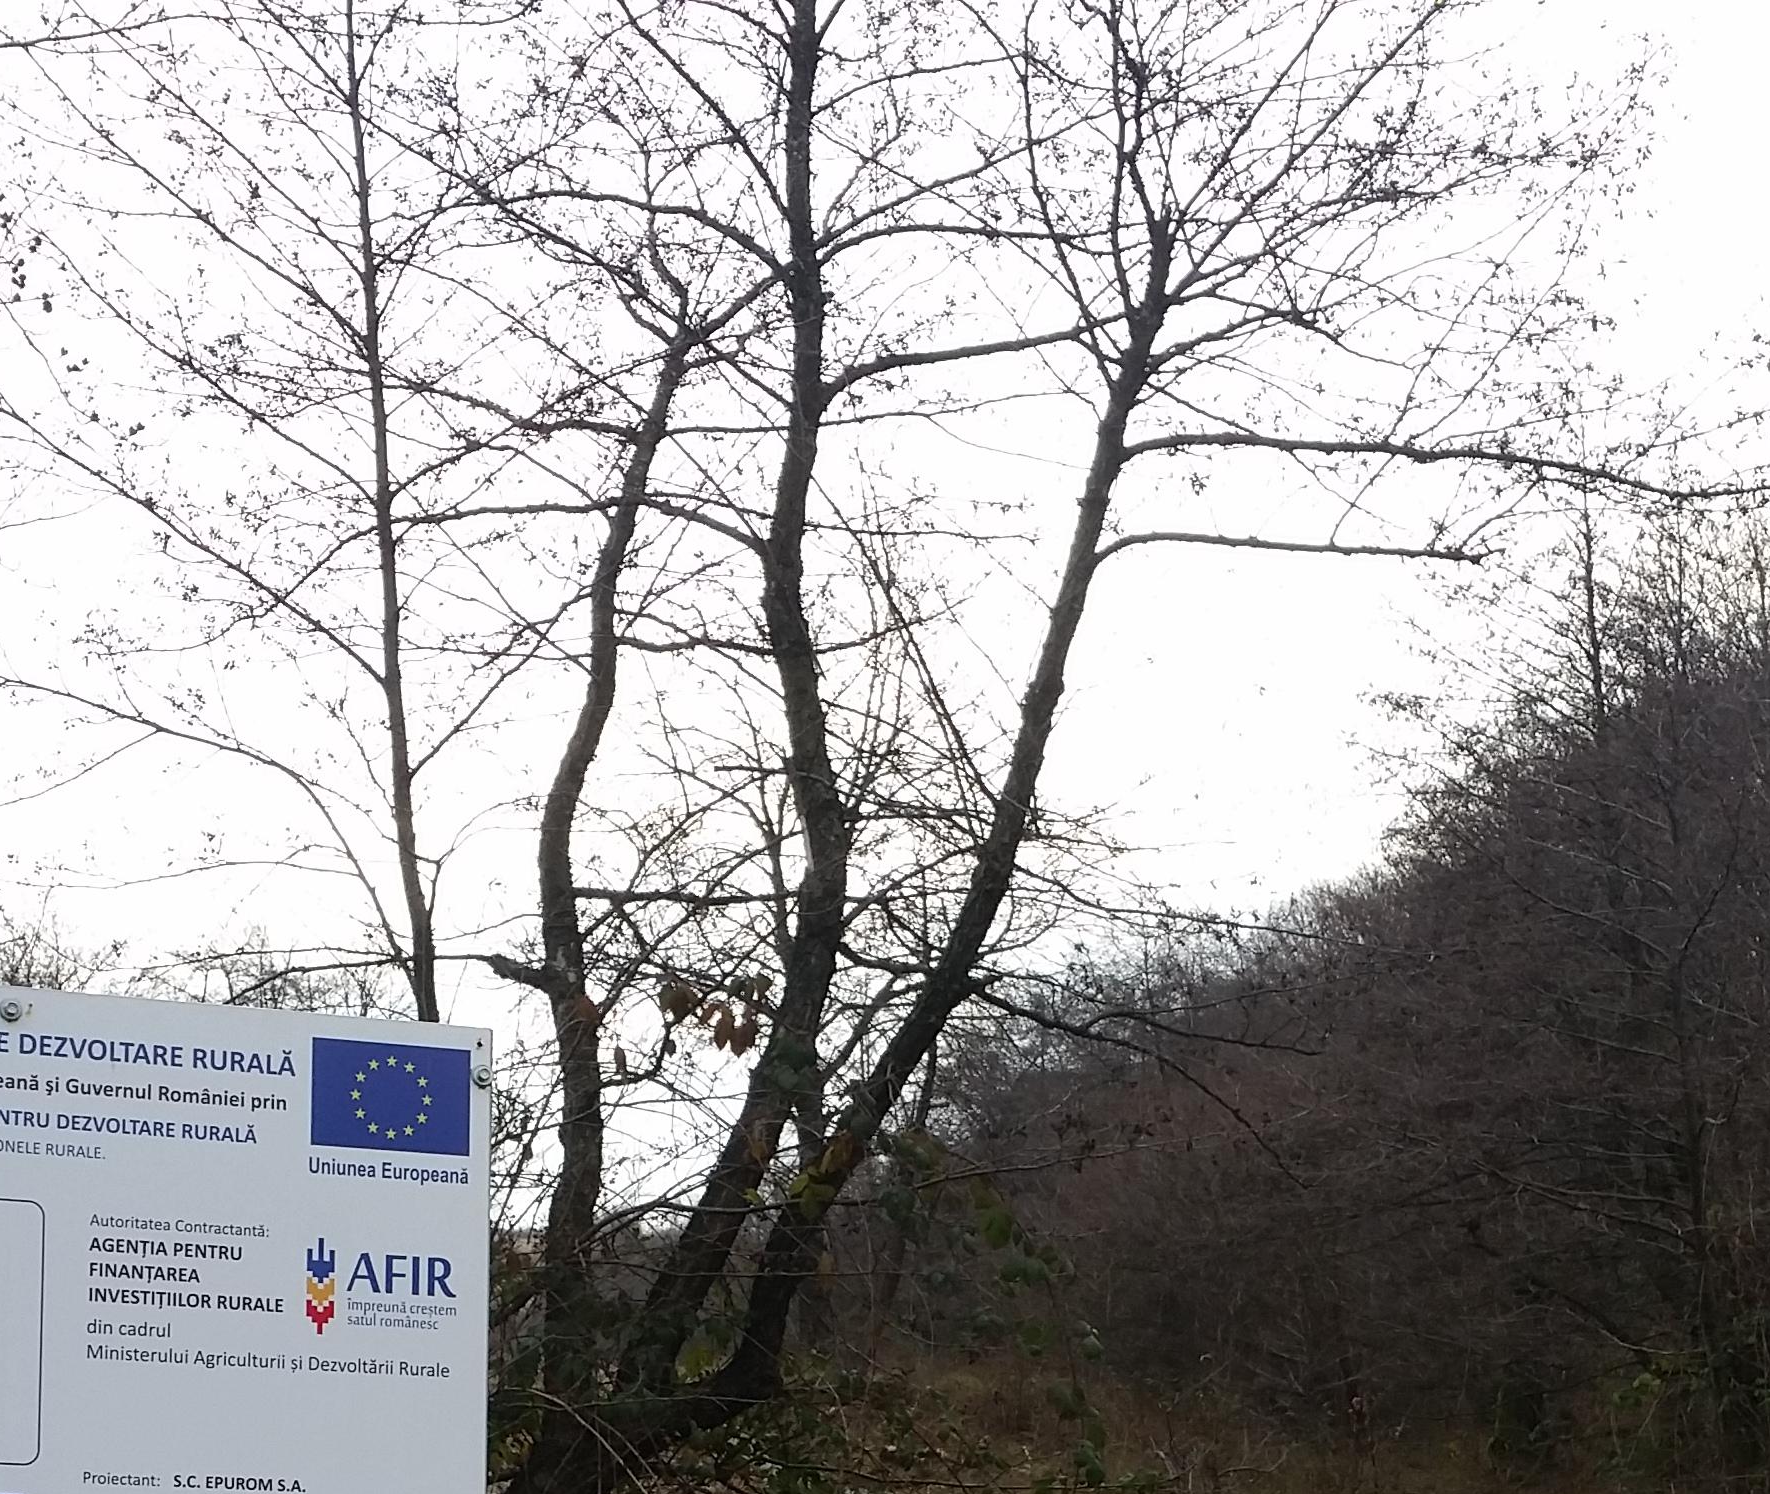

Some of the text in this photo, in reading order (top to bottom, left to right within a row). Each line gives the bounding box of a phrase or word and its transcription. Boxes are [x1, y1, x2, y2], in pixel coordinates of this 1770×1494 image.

[19, 1033, 184, 1068] DEZVOLTARE
[192, 1048, 296, 1077] RURALĂ
[65, 1078, 152, 1101] Guvernul
[158, 1085, 245, 1108] României
[251, 1093, 287, 1113] prin
[56, 1113, 176, 1138] DEZVOLTARE
[181, 1123, 257, 1145] RURALĂ
[45, 1143, 106, 1160] RURALE.
[309, 1156, 469, 1186] Uniunea Europeană
[89, 1213, 270, 1238] Autoritatea Contractantă:
[173, 1242, 242, 1261] PENTRU
[346, 1252, 457, 1301] AFIR
[217, 1295, 284, 1313] RURALE
[347, 1297, 407, 1316] împreună
[86, 1318, 171, 1338] din cadrul
[347, 1312, 439, 1330] satul românesc
[86, 1344, 189, 1364] Ministerului
[193, 1350, 286, 1369] Agriculturii
[308, 1356, 394, 1375] Dezvoltării
[399, 1361, 450, 1378] Rurale
[83, 1471, 306, 1493] Proiectant: S.C. EPUROM S.A.
